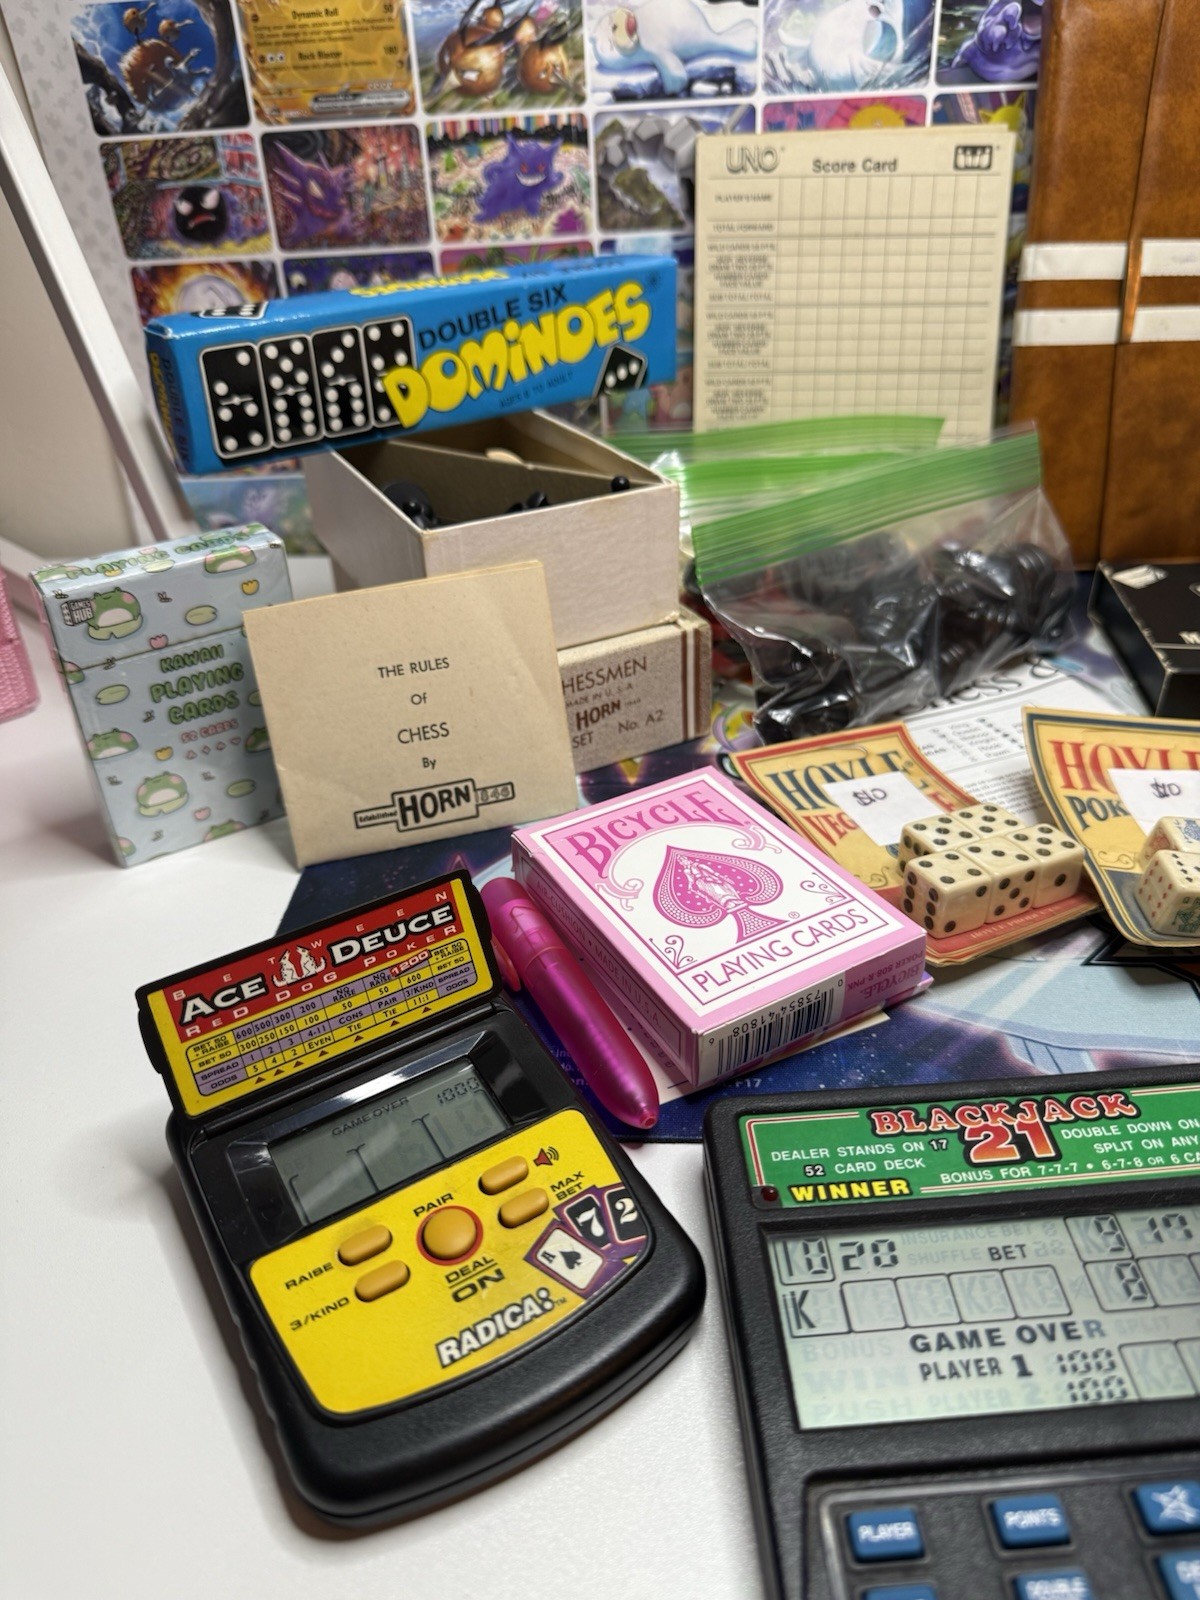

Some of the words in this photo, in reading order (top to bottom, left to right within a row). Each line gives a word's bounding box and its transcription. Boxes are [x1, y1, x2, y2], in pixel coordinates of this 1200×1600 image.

[726, 147, 779, 174] UNO
[812, 158, 856, 174] Score
[862, 156, 898, 173] Card
[419, 297, 522, 351] DOUBLE
[528, 282, 569, 312] SIX
[67, 549, 170, 579] PLAYING
[174, 530, 251, 554] CARDS
[70, 600, 91, 610] GAMES
[73, 608, 93, 623] HUB
[160, 644, 225, 673] KAWAII
[378, 664, 405, 678] THE
[410, 657, 450, 674] RULES
[150, 662, 245, 703] PLAYING
[562, 656, 648, 696] HESSMEN
[168, 690, 241, 724] CARDS
[576, 699, 621, 731] HORN
[397, 722, 450, 744] CHESS
[572, 731, 594, 749] SET
[645, 709, 664, 726] A2
[422, 757, 436, 770] By
[853, 788, 887, 806] $10
[1150, 778, 1182, 799] $10
[398, 785, 470, 827] HORN
[564, 791, 746, 879] BICYCLE
[180, 974, 268, 1025] ACE
[330, 903, 454, 966] DEUCE
[692, 939, 793, 993] PLAYING
[791, 908, 869, 948] CARDS
[895, 951, 923, 967] POKER
[185, 1006, 250, 1038] RED
[275, 971, 338, 1003] DOG
[363, 924, 457, 968] POKER
[236, 1027, 252, 1040] 600
[254, 1020, 271, 1032] 500
[275, 1012, 291, 1024] 300
[300, 1002, 316, 1013] 200
[336, 986, 350, 996] NO
[373, 972, 386, 981] NO
[391, 951, 429, 975] 1200
[332, 989, 356, 1002] RAISE
[861, 964, 920, 999] BICYCLE
[780, 989, 821, 1014] 73854
[198, 1057, 217, 1068] BET
[219, 1051, 232, 1059] 50
[240, 1039, 257, 1051] 300
[259, 1033, 276, 1044] 250
[279, 1025, 295, 1036] 150
[304, 1015, 320, 1026] 100
[342, 1001, 353, 1010] 50
[379, 986, 389, 995] 50
[406, 973, 422, 984] 600
[201, 1061, 239, 1081] SPREAD
[268, 1046, 275, 1054] 2
[288, 1038, 294, 1046] 3
[308, 1025, 326, 1037] 4-11
[338, 1011, 364, 1024] CONS
[377, 997, 398, 1009] PAIR
[405, 981, 434, 997] 3/KIND
[438, 966, 471, 983] SPREAD
[210, 1074, 238, 1090] ODDS
[253, 1064, 259, 1072] 5
[292, 1049, 298, 1057] 2
[308, 1035, 332, 1050] EVEN
[347, 1022, 362, 1033] TIE
[382, 1008, 397, 1018] TIE
[413, 994, 430, 1006] 11:1
[446, 978, 469, 992] ODDS
[733, 1010, 776, 1038] 41808
[332, 1114, 370, 1137] GAME
[372, 1096, 410, 1118] OVER
[870, 1093, 1138, 1135] BLACKJACK
[1060, 1125, 1121, 1140] DOUBLE
[1127, 1121, 1173, 1135] DOWN
[1177, 1118, 1200, 1130] ON
[771, 1148, 830, 1162] DEALER
[837, 1143, 895, 1158] STANDS
[903, 1141, 925, 1153] ON
[929, 1139, 948, 1151] 17
[964, 1117, 1056, 1164] 21
[1093, 1140, 1134, 1154] SPLIT
[1141, 1138, 1164, 1150] ON
[1171, 1135, 1199, 1148] ANY
[550, 1171, 585, 1192] MAX
[804, 1165, 825, 1177] 52
[834, 1160, 876, 1175] CARD
[884, 1158, 926, 1171] DECK
[940, 1168, 994, 1184] BONUS
[1000, 1166, 1032, 1180] FOR
[1037, 1162, 1078, 1176] 7-7-7
[1101, 1157, 1144, 1171] 6-7-8
[1147, 1156, 1165, 1167] OR
[1170, 1153, 1180, 1165] 6
[413, 1193, 455, 1217] PAIR
[555, 1183, 584, 1201] BET
[791, 1179, 910, 1201] WINNER
[541, 1250, 556, 1264] A
[577, 1207, 605, 1237] 7
[615, 1197, 638, 1224] 2
[987, 1243, 1028, 1262] BET
[285, 1262, 334, 1290] RAISE
[445, 1256, 496, 1284] DEAL
[452, 1268, 505, 1303] ON
[290, 1296, 350, 1331] 3/KIND
[909, 1328, 1006, 1353] GAME
[1016, 1319, 1106, 1344] OVER
[919, 1357, 1003, 1382] PLAYER
[1011, 1354, 1033, 1378] 1
[857, 1521, 917, 1543] PLAYER
[1003, 1507, 1062, 1529] POINTS
